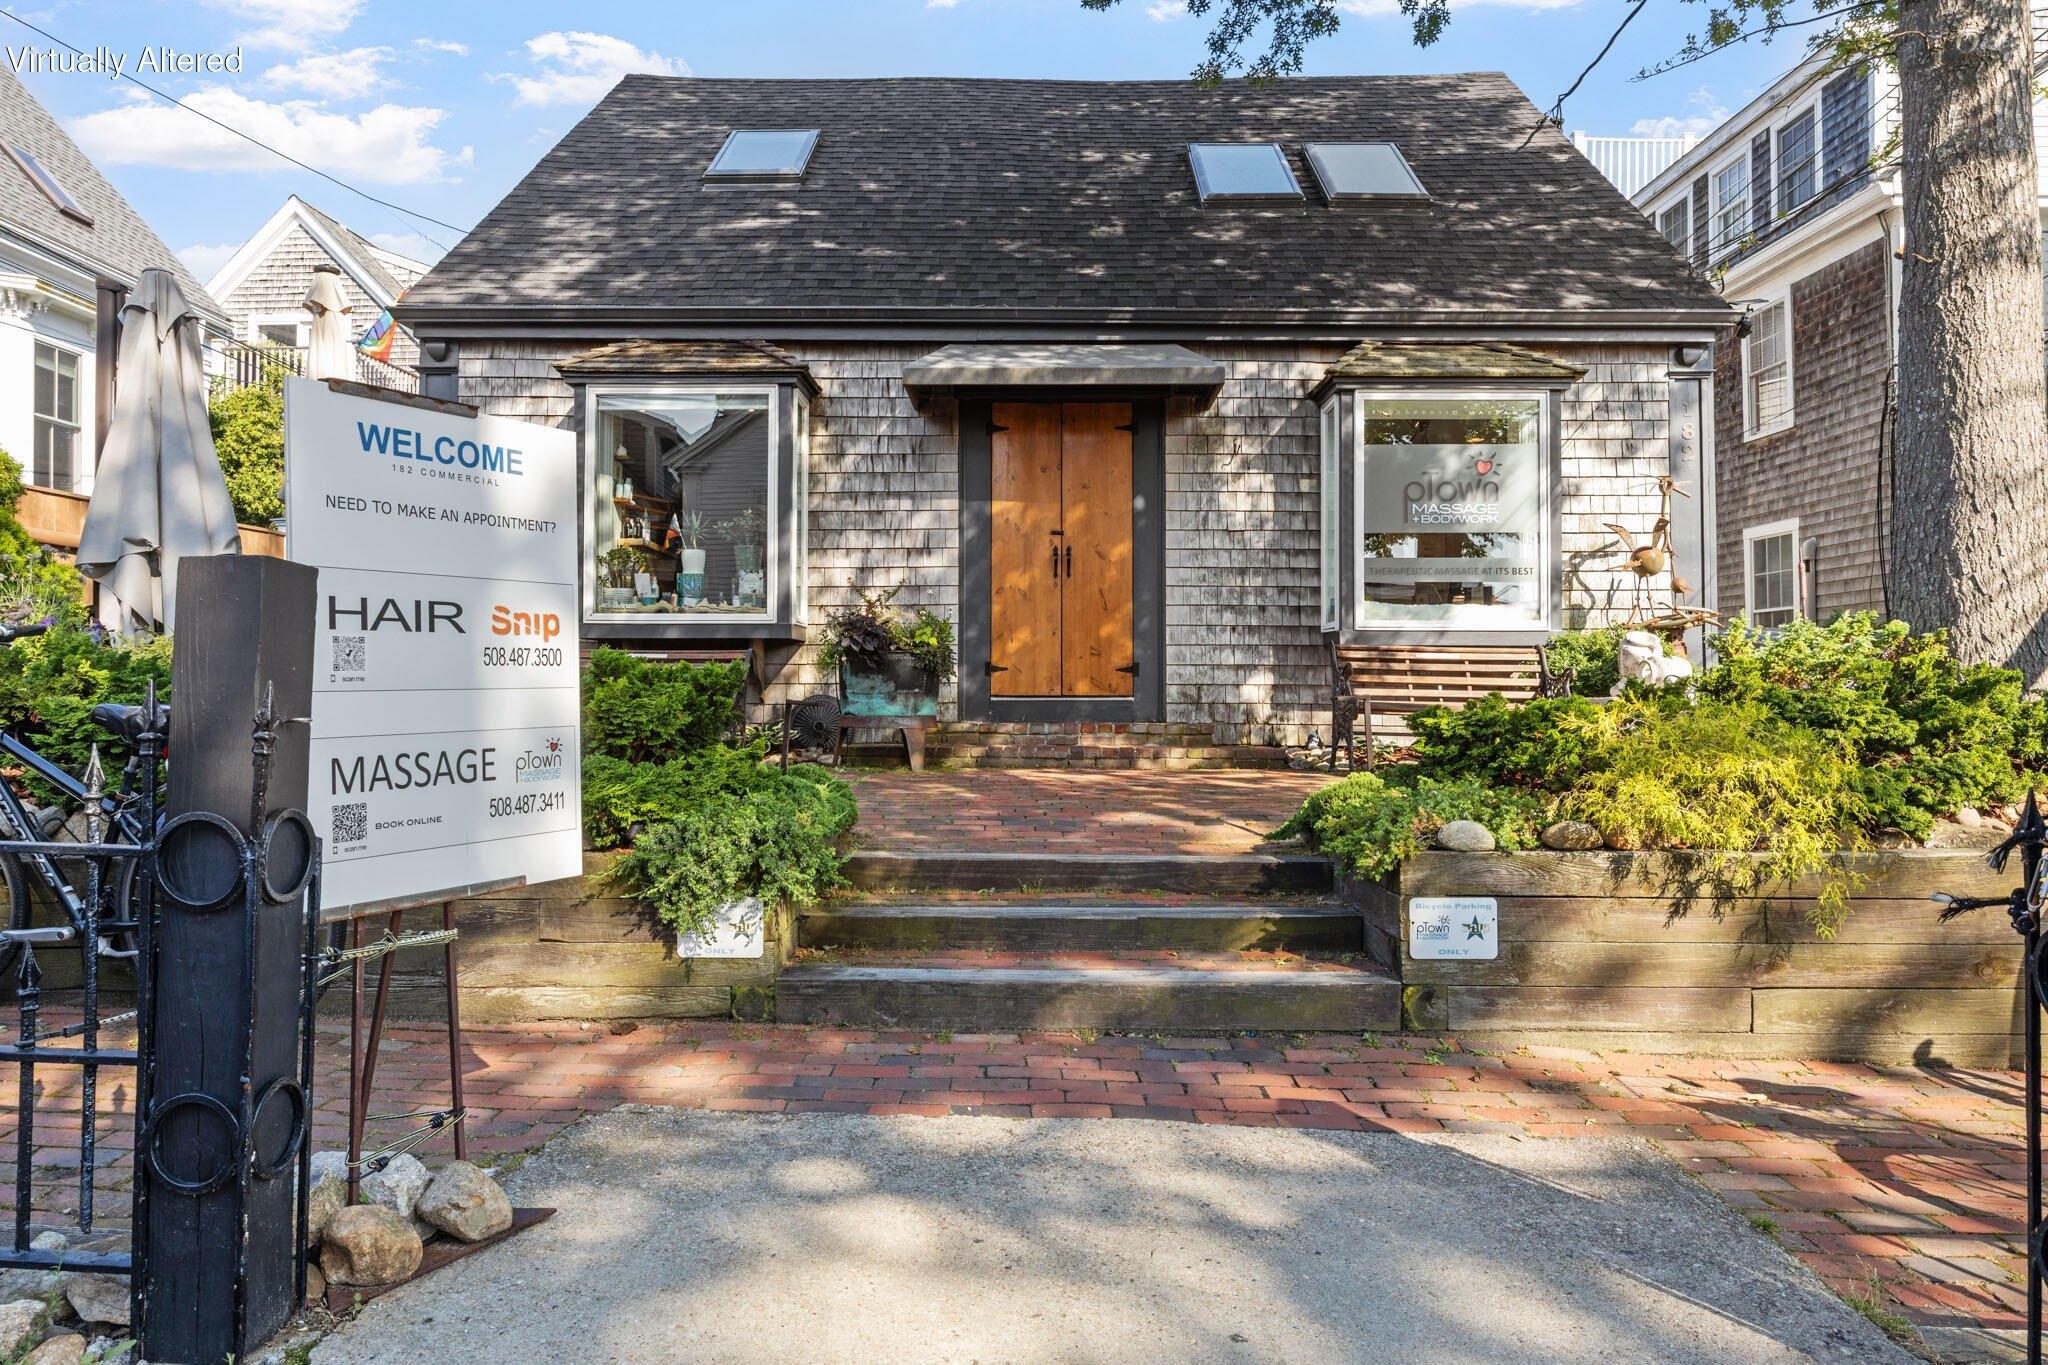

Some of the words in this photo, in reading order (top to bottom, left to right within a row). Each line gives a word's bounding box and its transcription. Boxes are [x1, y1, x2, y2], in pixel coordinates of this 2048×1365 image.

[1682, 402, 1696, 462] 182
[357, 421, 523, 476] WELCOME
[392, 464, 413, 474] 182
[420, 467, 500, 487] COMMERCIAL
[325, 494, 367, 511] NEED
[372, 500, 392, 514] TO
[398, 503, 436, 520] MAKE
[440, 509, 459, 522] AN
[463, 511, 557, 534] APPOINTMENT?
[1412, 503, 1499, 514] MASSAGE
[1412, 514, 1501, 524] +BODYWORK
[1369, 567, 1432, 576] THERAPEUTIC
[1434, 567, 1480, 576] MASSAGE
[1482, 567, 1493, 575] AT
[1495, 567, 1509, 575] ITS
[1512, 567, 1534, 575] BEST
[328, 595, 466, 634] HAIR
[491, 604, 560, 642] Snip
[483, 647, 562, 667] 508.487.3500
[331, 748, 496, 795] MASSAGE
[520, 767, 561, 777] MASSAGE
[489, 790, 564, 818] 508.487.3411
[375, 820, 404, 830] BOOK
[406, 816, 443, 826] ONLINE
[1454, 903, 1492, 911] Parking
